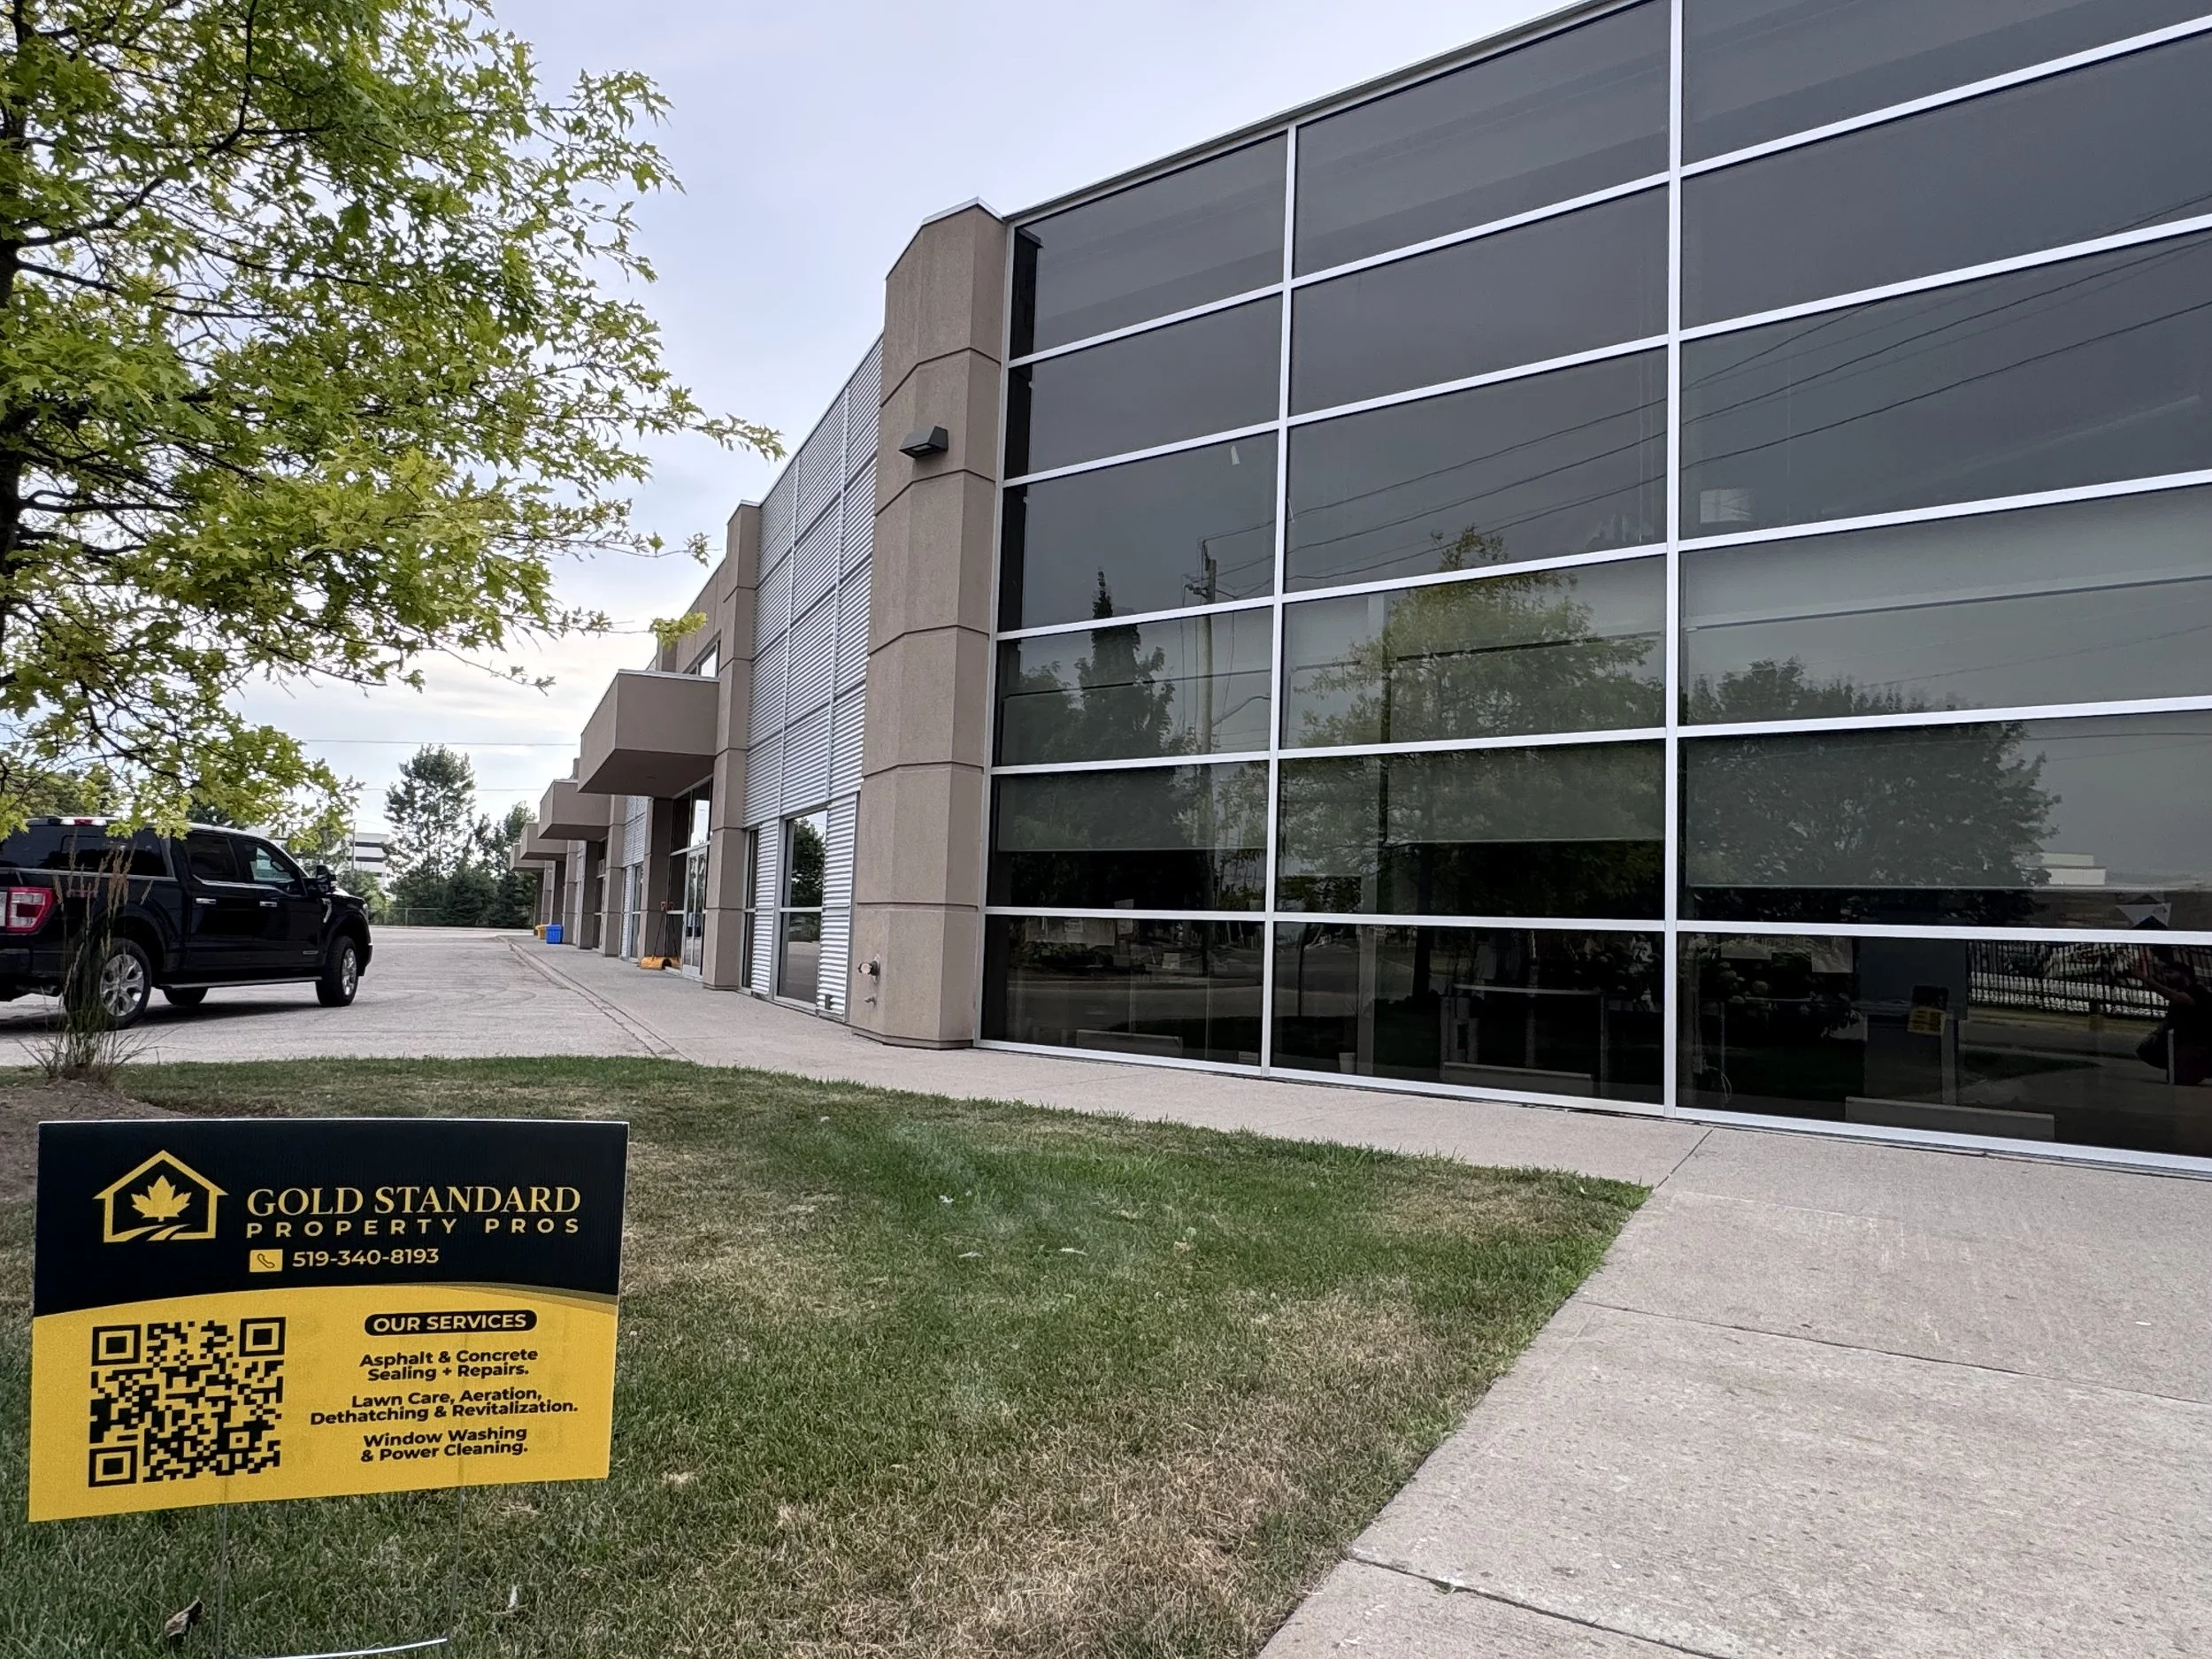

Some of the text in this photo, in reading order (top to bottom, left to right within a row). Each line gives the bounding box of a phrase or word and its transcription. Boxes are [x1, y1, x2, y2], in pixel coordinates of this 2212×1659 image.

[247, 1186, 581, 1216] GOLD STANDARD
[246, 1217, 580, 1239] PROPERTY PROS
[292, 1248, 439, 1267] 519-340-8193
[373, 1313, 527, 1333] OUR SERVICES
[359, 1348, 538, 1369] Asphalt & Concrete
[367, 1362, 529, 1382] Sealing + Repairs.
[351, 1386, 542, 1408] Lawn Care, Aeration,
[310, 1399, 579, 1425] Dethatching & Revitalization.
[363, 1426, 527, 1448] Window Washing
[360, 1441, 528, 1462] & Power Cleaning.
